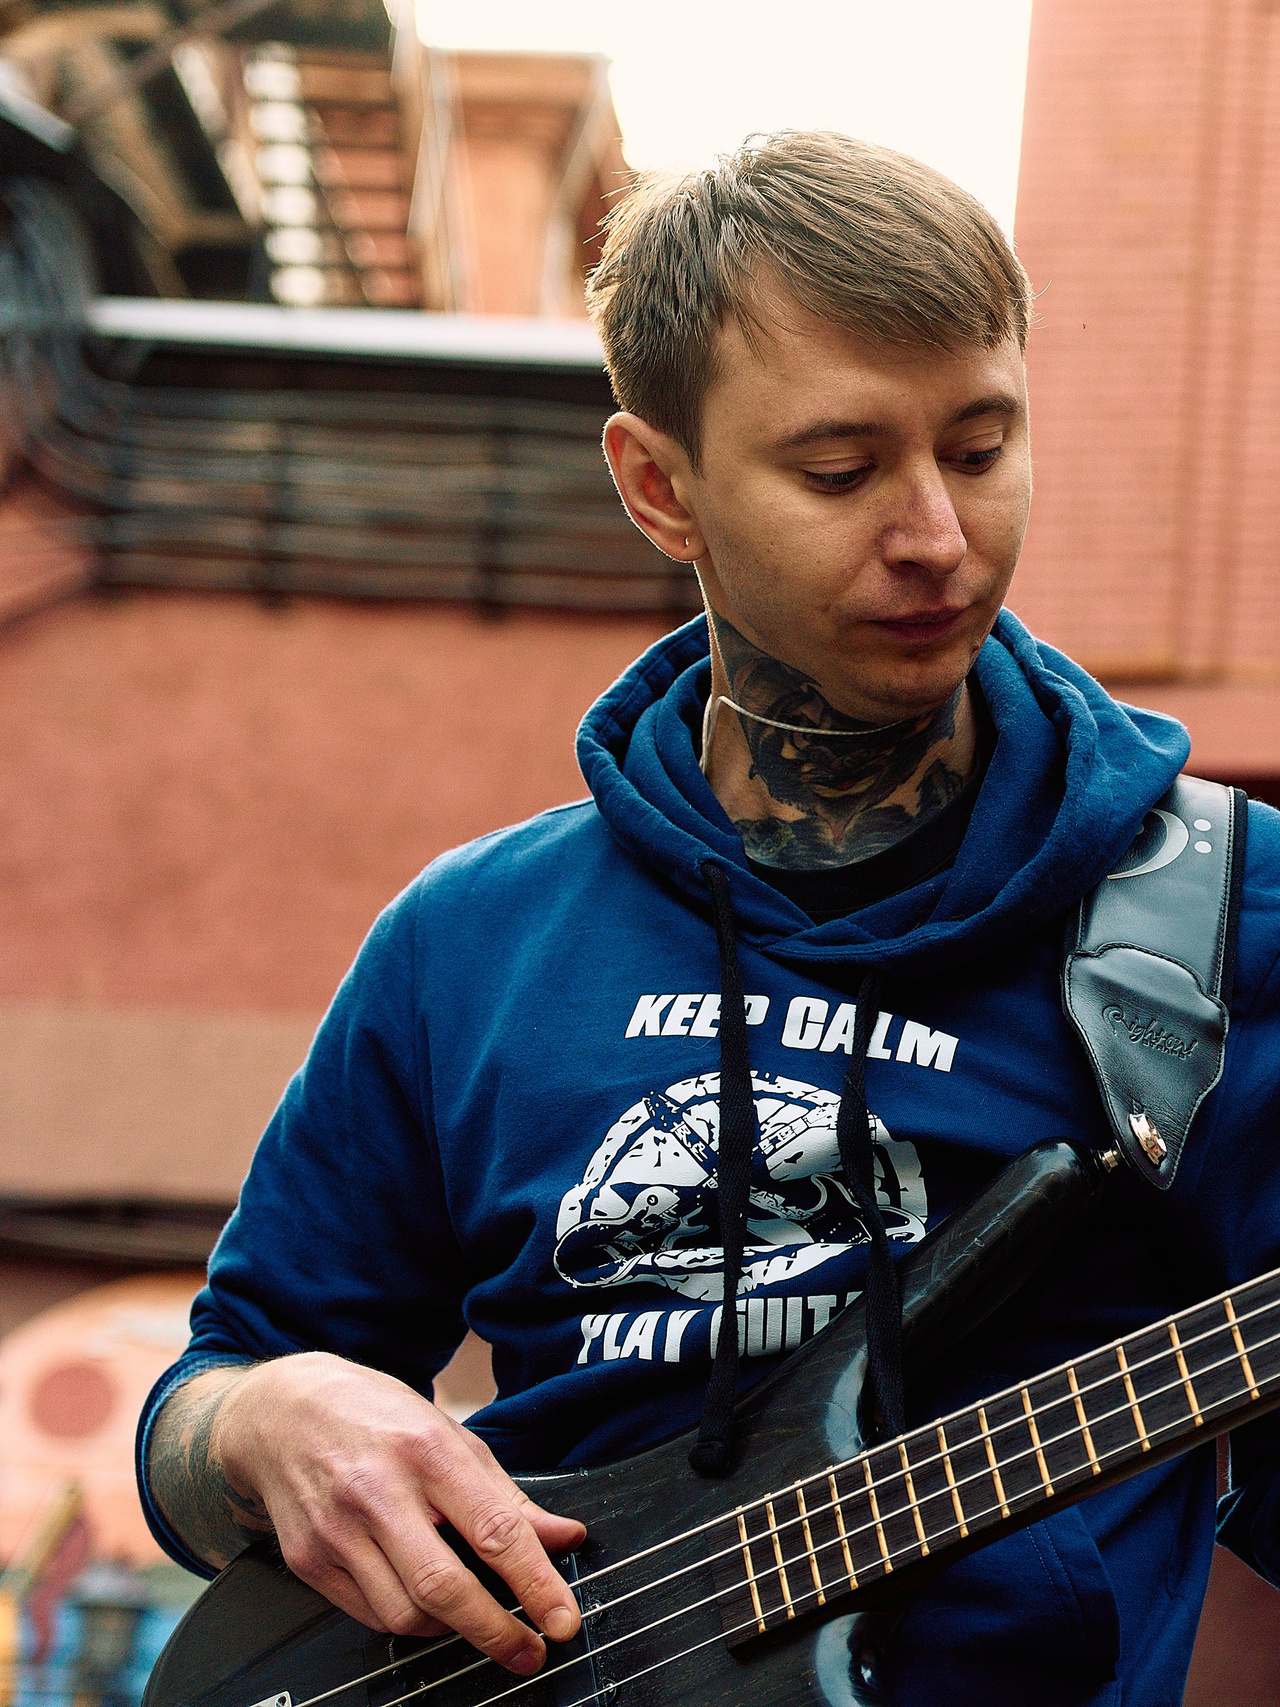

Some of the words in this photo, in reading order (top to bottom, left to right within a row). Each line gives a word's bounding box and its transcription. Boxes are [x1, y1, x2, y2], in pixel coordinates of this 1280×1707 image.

[624, 994, 770, 1039] KEEP
[781, 996, 960, 1073] CALM
[577, 1308, 705, 1365] PLAY
[710, 1290, 864, 1360] GUIT
